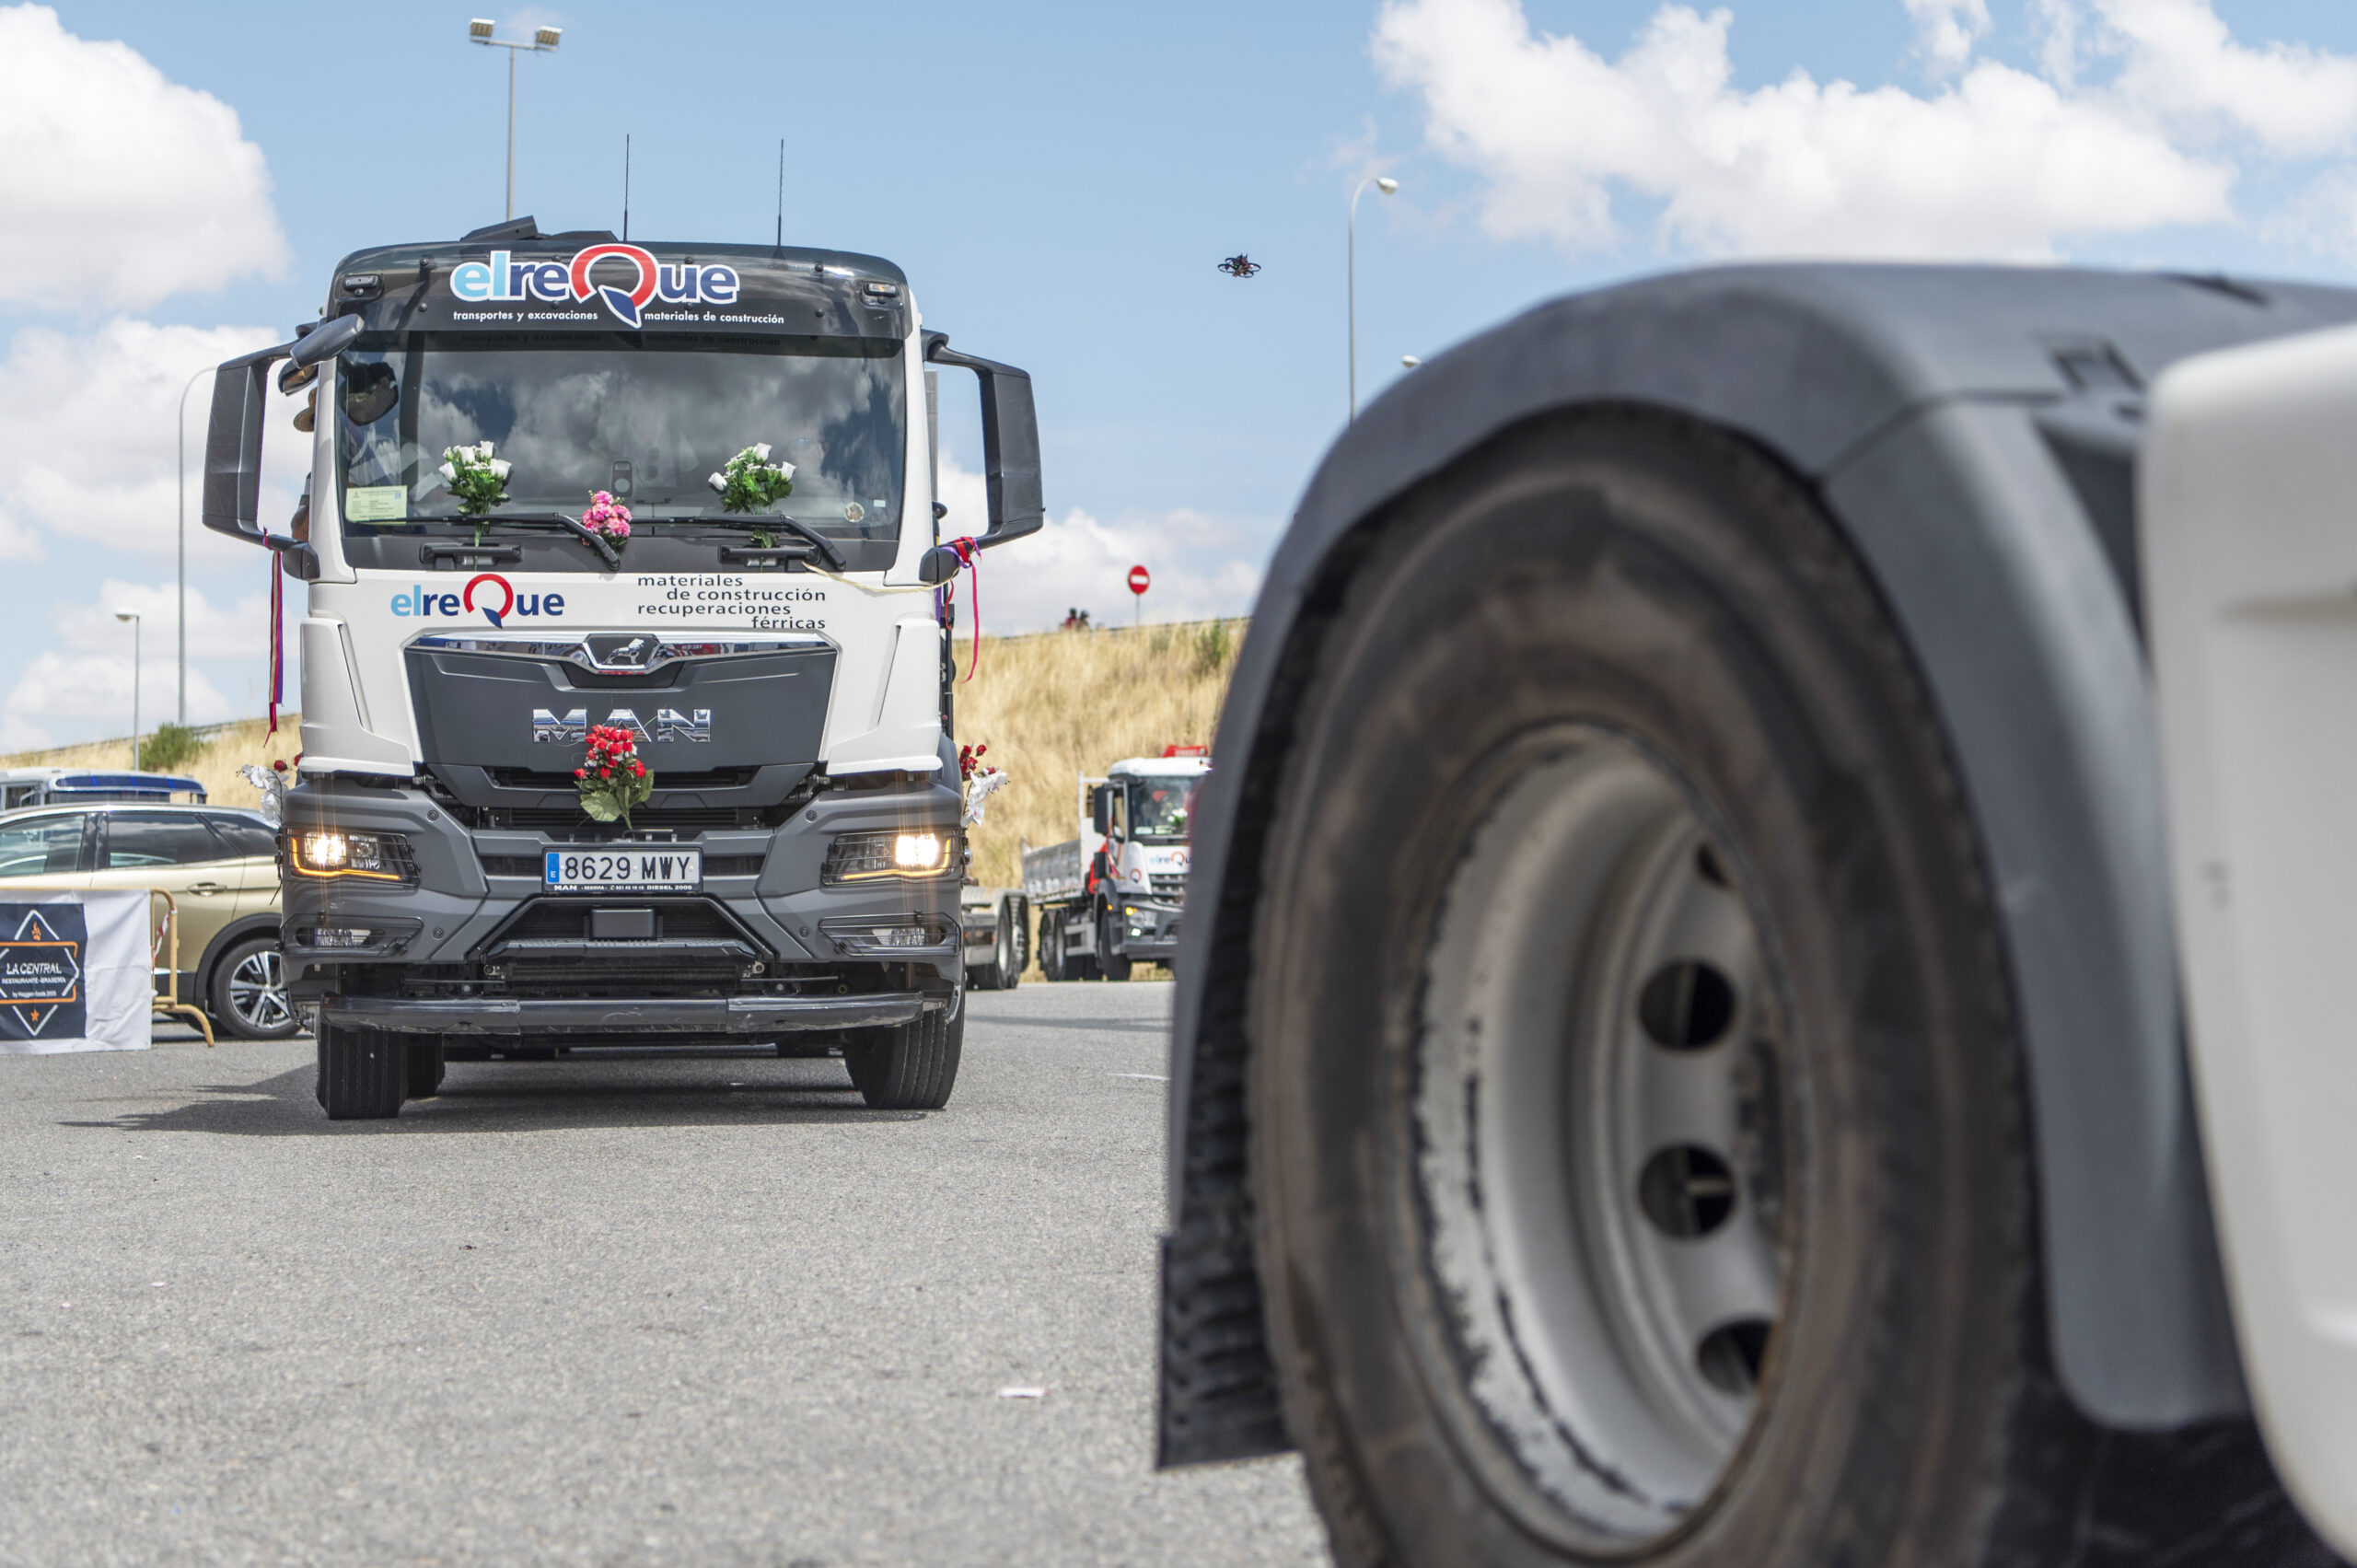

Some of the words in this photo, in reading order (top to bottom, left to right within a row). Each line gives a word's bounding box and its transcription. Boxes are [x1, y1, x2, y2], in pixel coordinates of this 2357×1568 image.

[450, 243, 739, 328] elreQue
[453, 311, 513, 322] transportes
[517, 312, 525, 322] y
[528, 310, 598, 320] excavaciones
[644, 311, 700, 321] materiales
[703, 311, 716, 321] de
[720, 314, 784, 324] construcción
[638, 575, 743, 587] materiales
[667, 587, 691, 600] de
[697, 588, 826, 601] construcción
[390, 574, 564, 629] elreQue
[638, 602, 791, 617] recuperaciones
[751, 615, 826, 629] férricas
[532, 708, 712, 743] MAN
[564, 856, 631, 880] 8629
[642, 856, 690, 880] MWY
[6, 962, 19, 975] LA
[19, 962, 63, 975] CENTRAL
